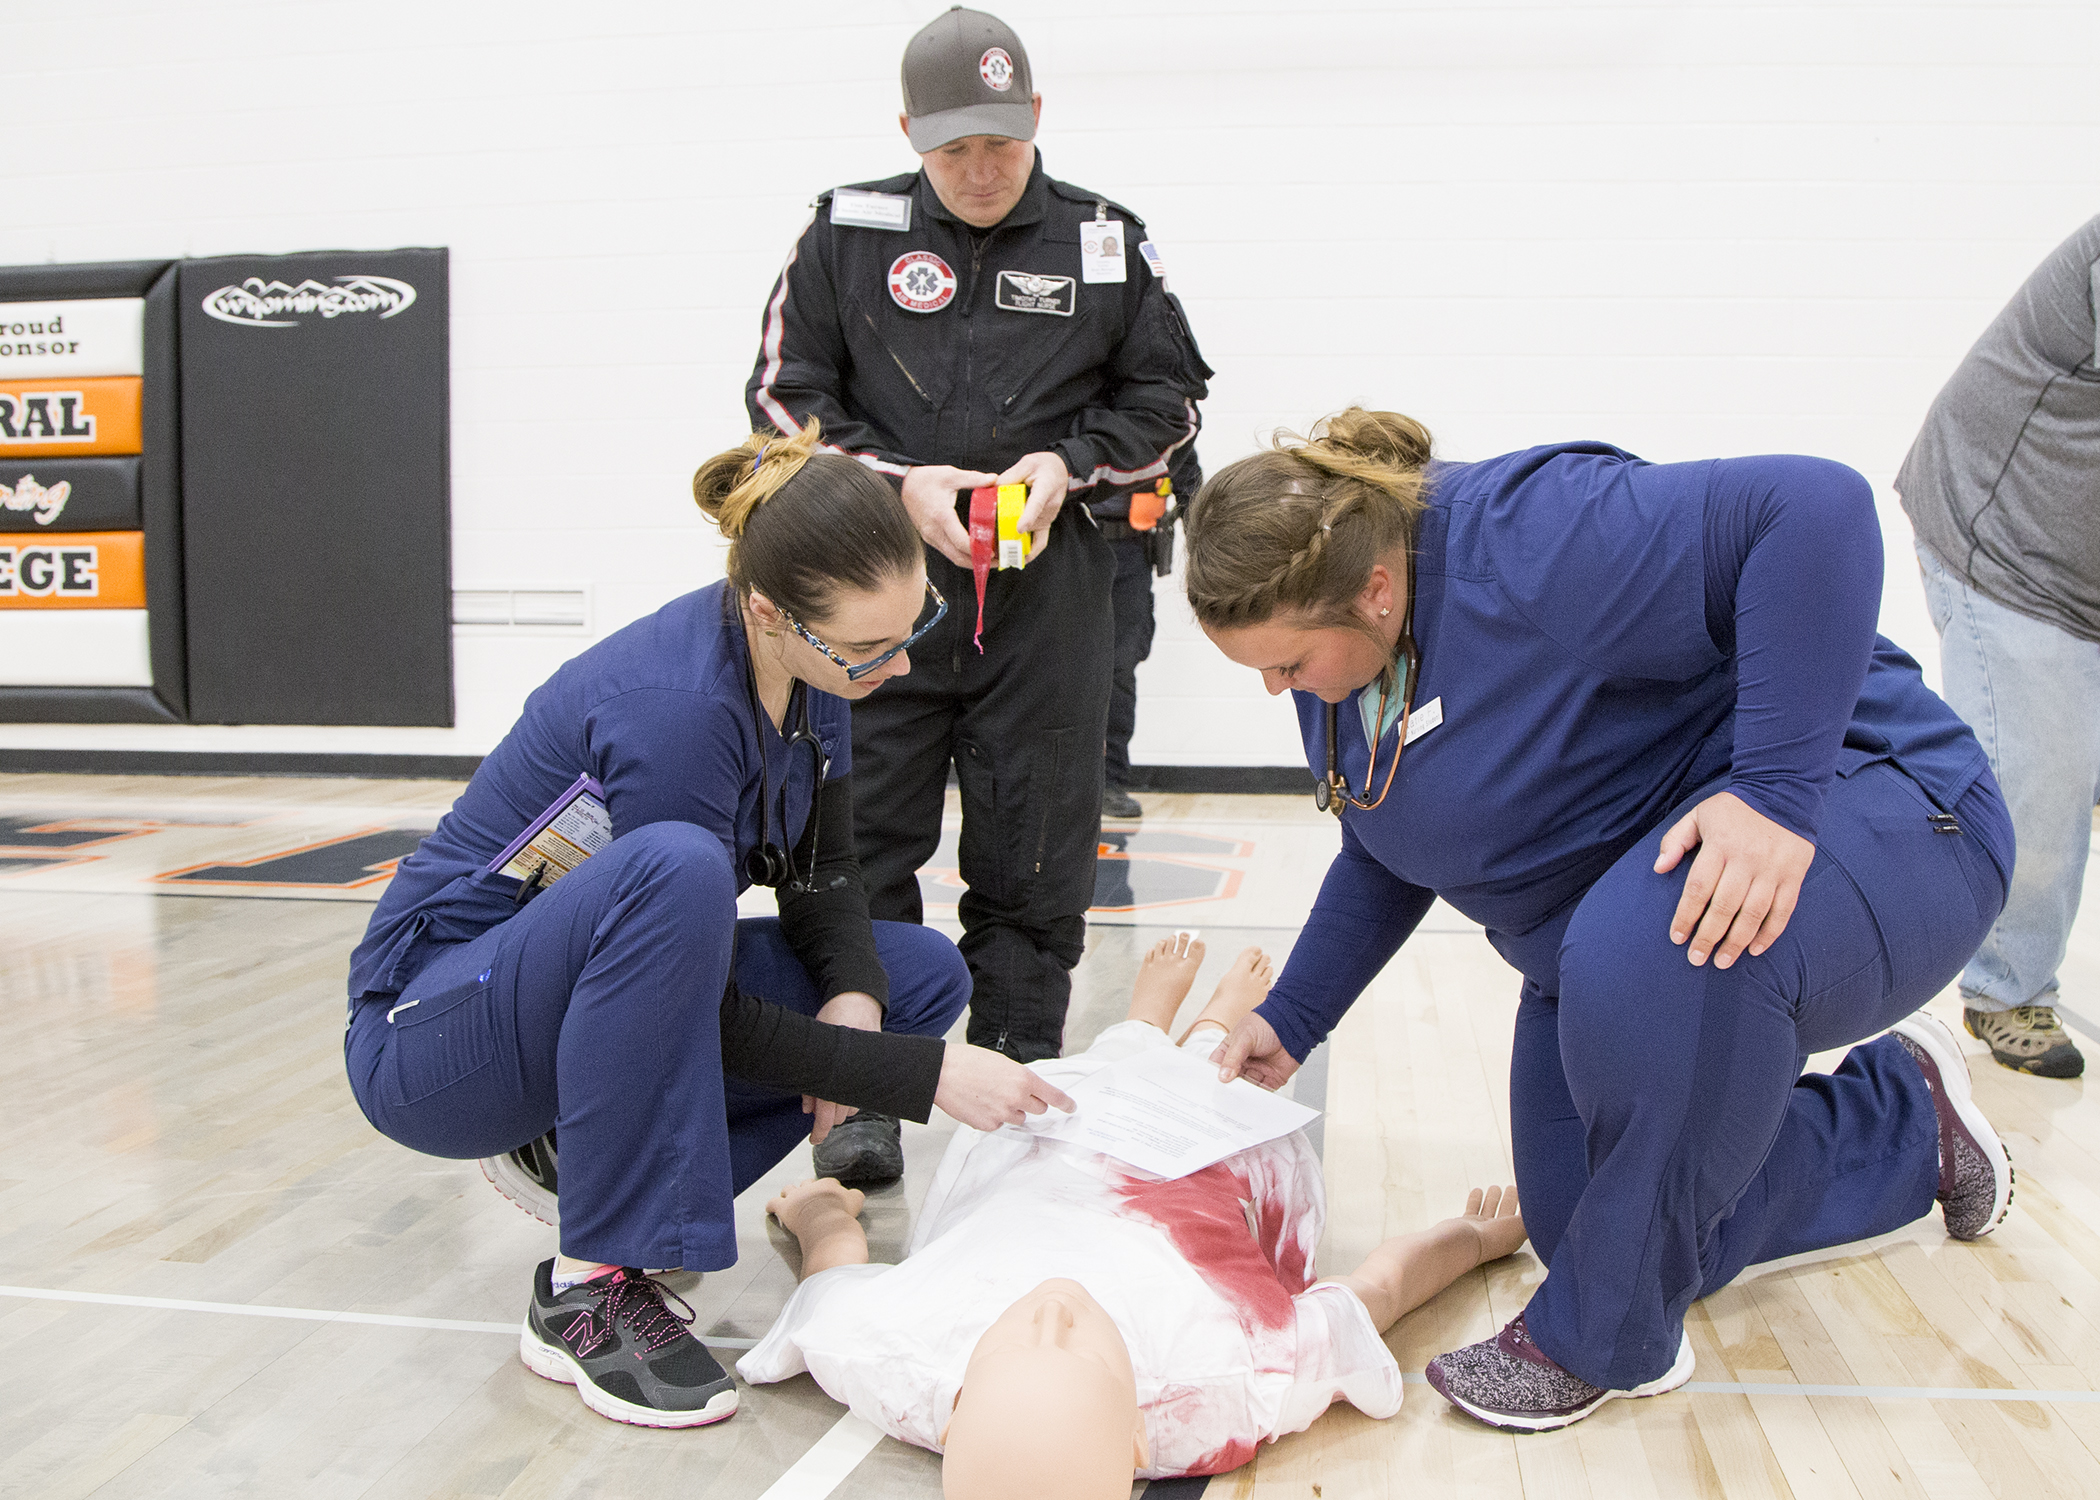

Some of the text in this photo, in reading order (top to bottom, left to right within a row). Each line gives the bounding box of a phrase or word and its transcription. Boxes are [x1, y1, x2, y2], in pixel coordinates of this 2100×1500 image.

[904, 254, 942, 267] CLASSIC
[215, 291, 400, 321] wyoming.com
[895, 291, 948, 310] AIR MEDICAL
[0, 342, 79, 356] onsor
